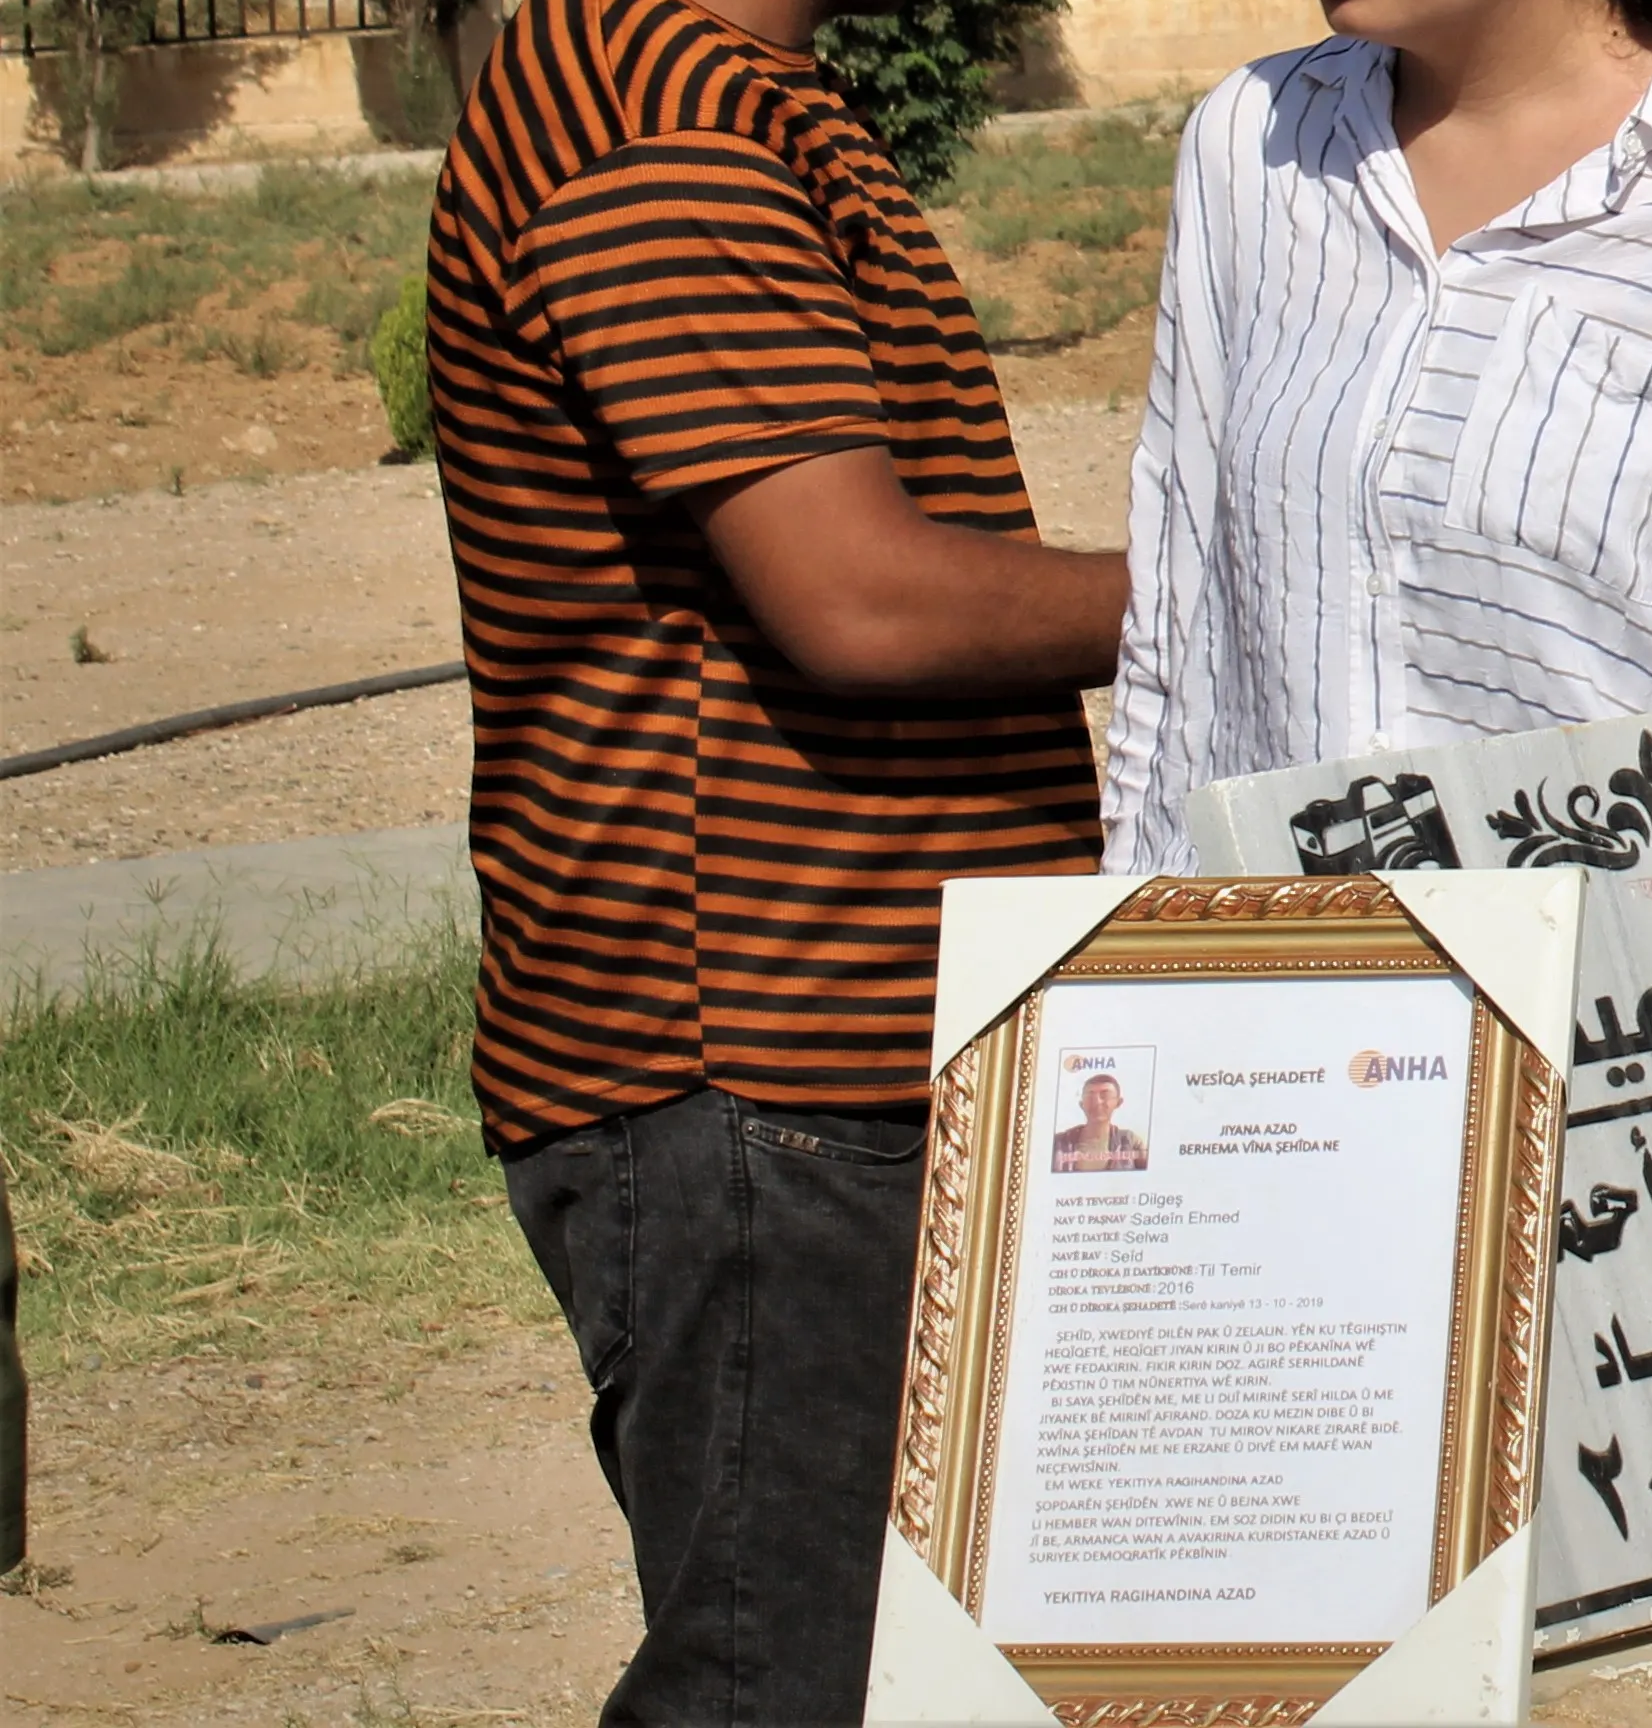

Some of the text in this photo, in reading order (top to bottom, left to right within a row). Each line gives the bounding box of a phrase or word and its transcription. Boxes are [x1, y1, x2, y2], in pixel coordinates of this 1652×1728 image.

[1072, 1056, 1117, 1071] ANHA
[1363, 1055, 1449, 1083] ANHA
[1219, 1123, 1297, 1137] JIYANA AZAD
[1179, 1143, 1239, 1156] BERHEMA
[1323, 1140, 1340, 1152] NE
[1138, 1192, 1183, 1209] Dilgeş
[1053, 1215, 1076, 1226] NAV
[1188, 1210, 1240, 1225] Ehmed
[1223, 1263, 1262, 1276] Temir
[1157, 1280, 1194, 1296] 2016
[1196, 1327, 1220, 1338] PAK
[1318, 1325, 1336, 1336] KU
[1169, 1344, 1204, 1356] JIYAN
[1206, 1343, 1240, 1355] KIRIN
[1267, 1342, 1286, 1353] BO
[1044, 1363, 1072, 1375] XWE
[1074, 1361, 1142, 1374] FEDAKIRIN.
[1145, 1360, 1177, 1372] FIKIR
[1179, 1360, 1212, 1372] KIRIN
[1111, 1378, 1135, 1390] TIM
[1235, 1375, 1272, 1387] KIRIN.
[1065, 1396, 1096, 1407] SAYA
[1181, 1393, 1201, 1404] ME
[1321, 1390, 1358, 1401] HILDA
[1374, 1389, 1393, 1400] ME
[1039, 1412, 1087, 1425] JIYANEK
[1153, 1409, 1212, 1423] AFIRAND.
[1215, 1409, 1250, 1421] DOZA
[1253, 1409, 1270, 1420] KU
[1273, 1408, 1314, 1419] MEZIN
[1317, 1407, 1346, 1419] DIBE
[1159, 1427, 1203, 1439] AVDAN
[1209, 1426, 1227, 1438] TU
[1230, 1425, 1274, 1437] MIROV
[1276, 1424, 1321, 1436] NIKARE
[1139, 1444, 1159, 1455] ME
[1163, 1443, 1180, 1454] NE
[1183, 1442, 1231, 1454] ERZANE
[1279, 1441, 1299, 1452] EM
[1341, 1440, 1372, 1451] WAN
[1044, 1475, 1284, 1491] EM WEKE YEKITIYA RAGIHANDINA AZAD
[1165, 1497, 1194, 1509] XWE
[1196, 1497, 1214, 1508] NE
[1271, 1495, 1300, 1507] XWE
[1045, 1517, 1098, 1530] HEMBER
[1101, 1516, 1132, 1529] WAN
[1210, 1515, 1230, 1527] EM
[1233, 1514, 1257, 1526] SOZ
[1260, 1513, 1296, 1525] DIDIN
[1299, 1513, 1316, 1524] KU
[1063, 1533, 1130, 1546] ARMANCA
[1132, 1533, 1163, 1545] WAN
[1177, 1531, 1245, 1544] AVAKIRINA
[1247, 1529, 1340, 1542] KURDISTANEKE
[1343, 1529, 1377, 1541] AZAD
[1029, 1551, 1080, 1563] SURIYEK
[1044, 1588, 1256, 1604] YEKITIYA RAGIHANDINA AZAD
